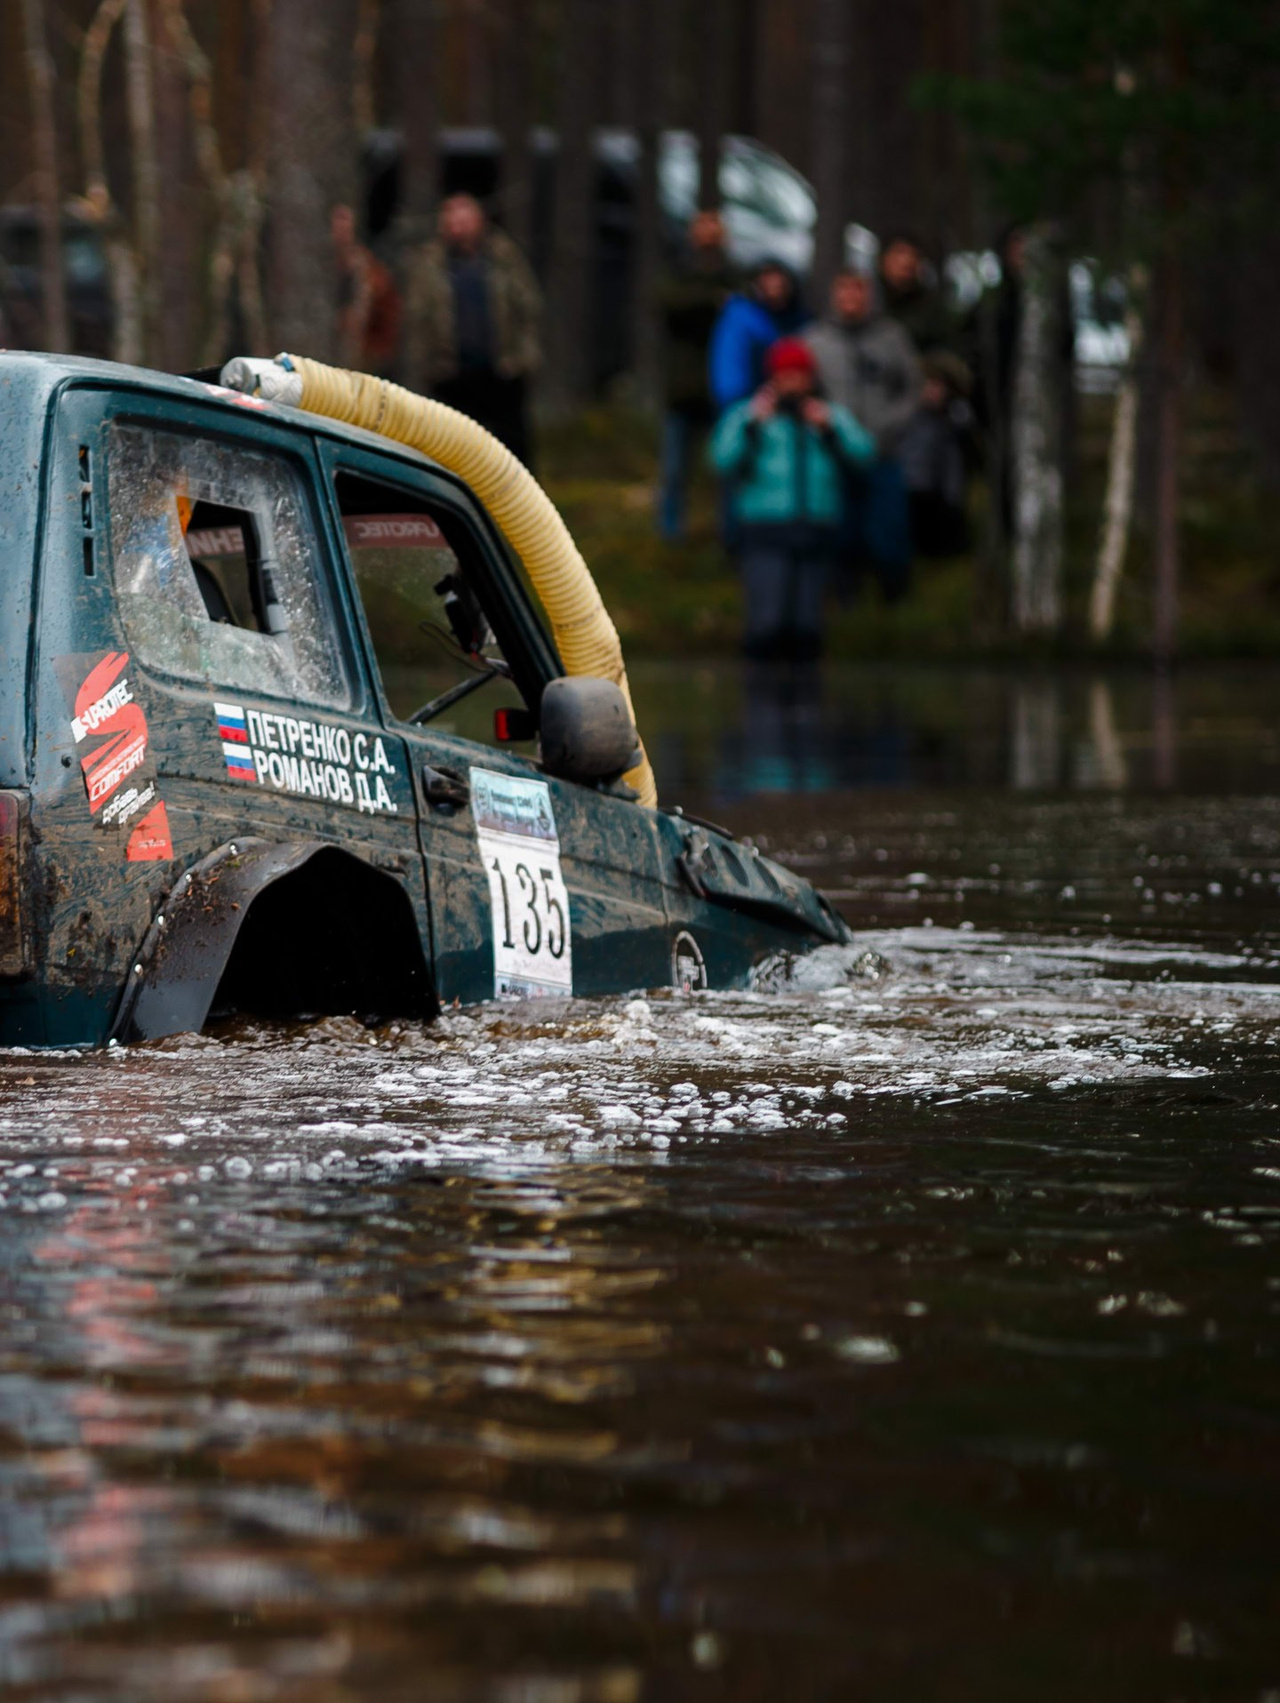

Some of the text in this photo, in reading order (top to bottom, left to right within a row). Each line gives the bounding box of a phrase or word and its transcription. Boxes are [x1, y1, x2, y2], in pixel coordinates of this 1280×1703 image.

[90, 743, 146, 802] COMFORT
[247, 709, 395, 774] ПЕТРЕНКО С.А.
[253, 749, 397, 815] РОМАНОВ Д.А.
[492, 857, 566, 960] 135
